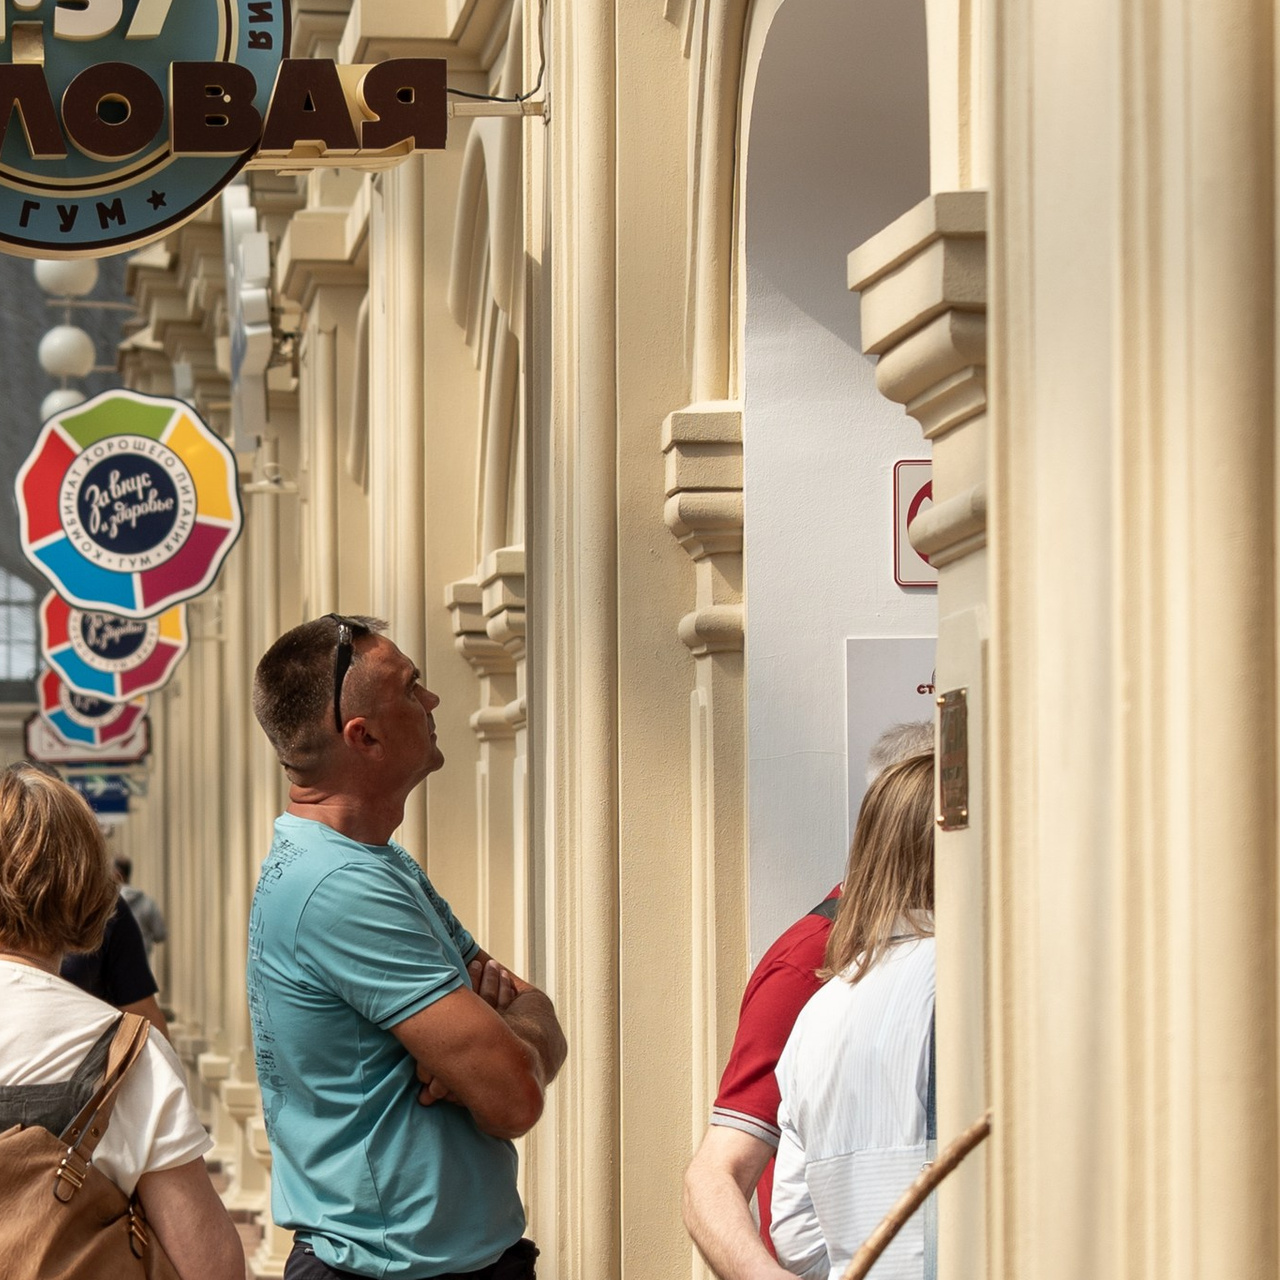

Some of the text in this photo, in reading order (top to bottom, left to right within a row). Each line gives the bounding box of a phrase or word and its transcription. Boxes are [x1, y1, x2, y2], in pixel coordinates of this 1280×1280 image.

[18, 197, 127, 233] ГУМ
[62, 439, 193, 560] КОМБИНАТ ХОРОШЕГО ПИТАНИЯ
[84, 469, 153, 535] За вкус
[108, 487, 175, 539] здоровье
[118, 556, 152, 568] ГУМ
